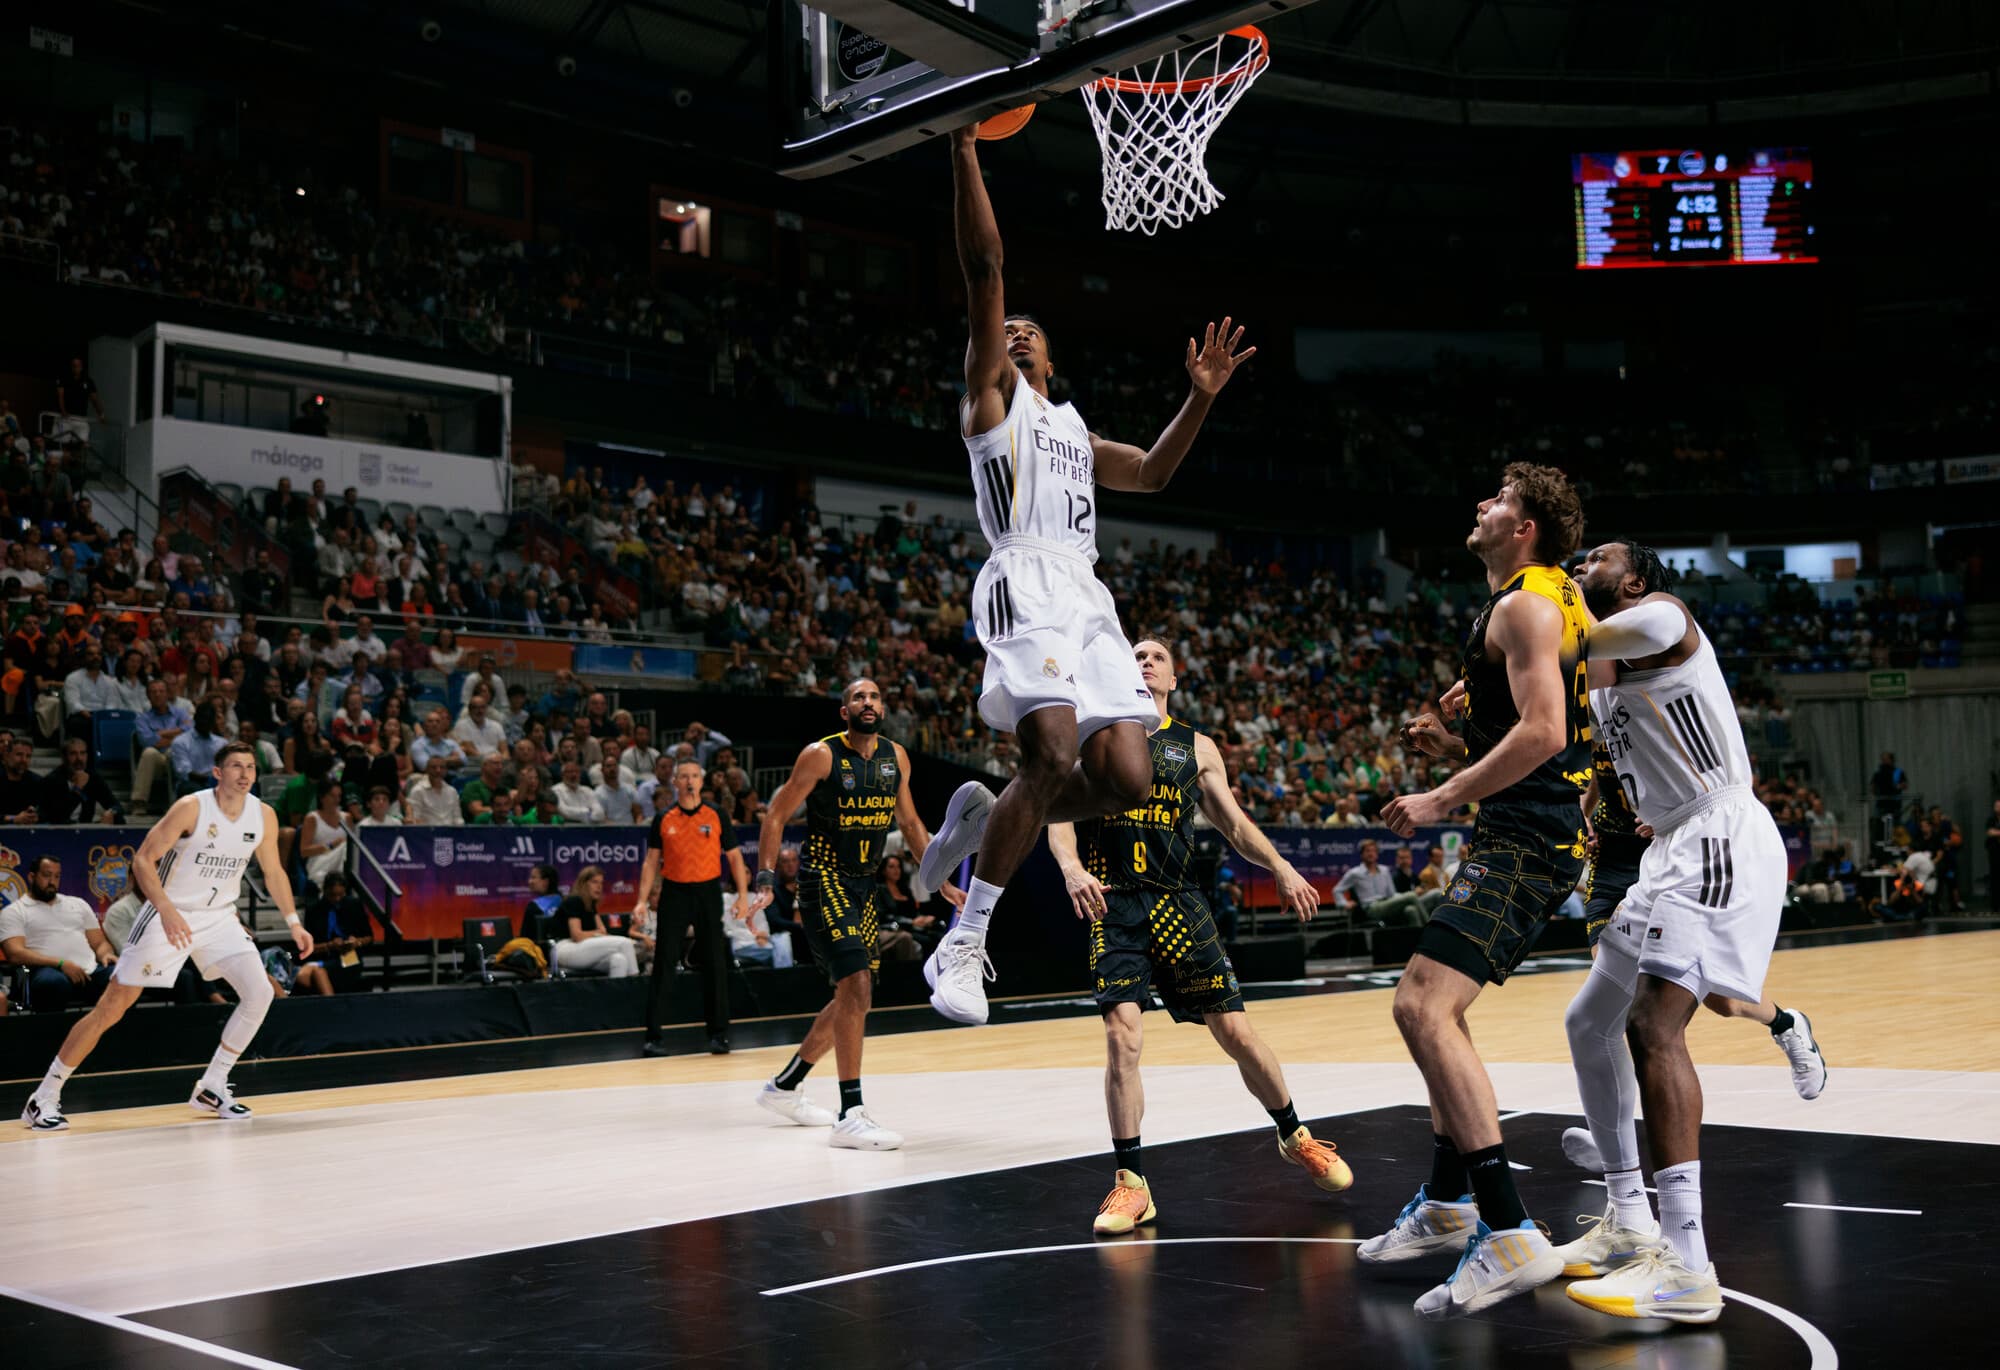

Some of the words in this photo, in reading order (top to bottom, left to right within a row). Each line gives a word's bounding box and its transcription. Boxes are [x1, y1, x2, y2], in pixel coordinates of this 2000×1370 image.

[1657, 156, 1670, 174] 7
[1676, 195, 1718, 214] 4:52
[1670, 236, 1681, 251] 2
[1711, 235, 1722, 250] 4
[252, 446, 324, 473] málaga
[1050, 457, 1067, 476] FLY
[1064, 489, 1091, 533] 12
[838, 796, 856, 808] LA
[556, 840, 640, 863] endesa
[1133, 841, 1147, 874] 9
[199, 867, 214, 878] FLY
[207, 886, 218, 907] 7
